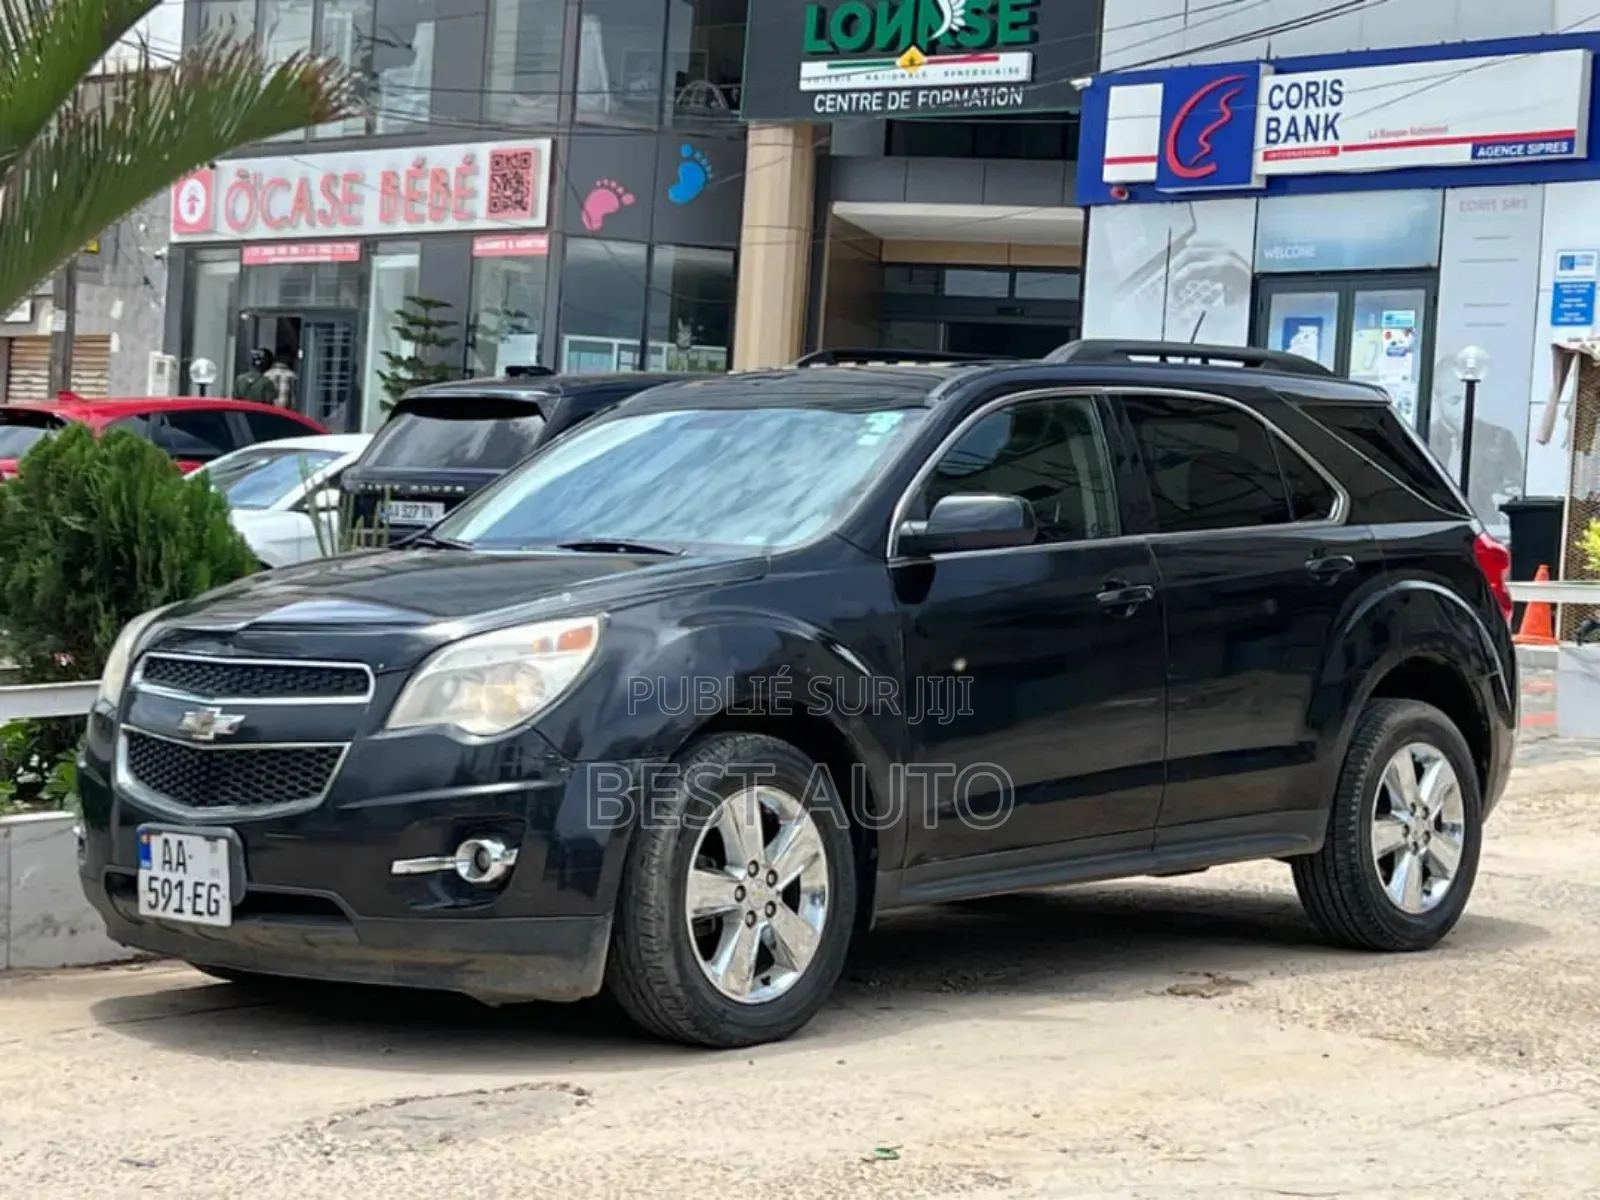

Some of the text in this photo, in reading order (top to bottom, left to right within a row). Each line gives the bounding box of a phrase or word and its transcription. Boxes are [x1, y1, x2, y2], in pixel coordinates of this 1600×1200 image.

[813, 87, 1024, 113] CENTRE DE FORMATION
[1268, 79, 1344, 111] CORIS
[1265, 113, 1342, 145] BANK
[1477, 142, 1569, 157] AGENCE SIPRES
[379, 154, 479, 225] BÉBÉ
[1264, 245, 1317, 260] WELCOME
